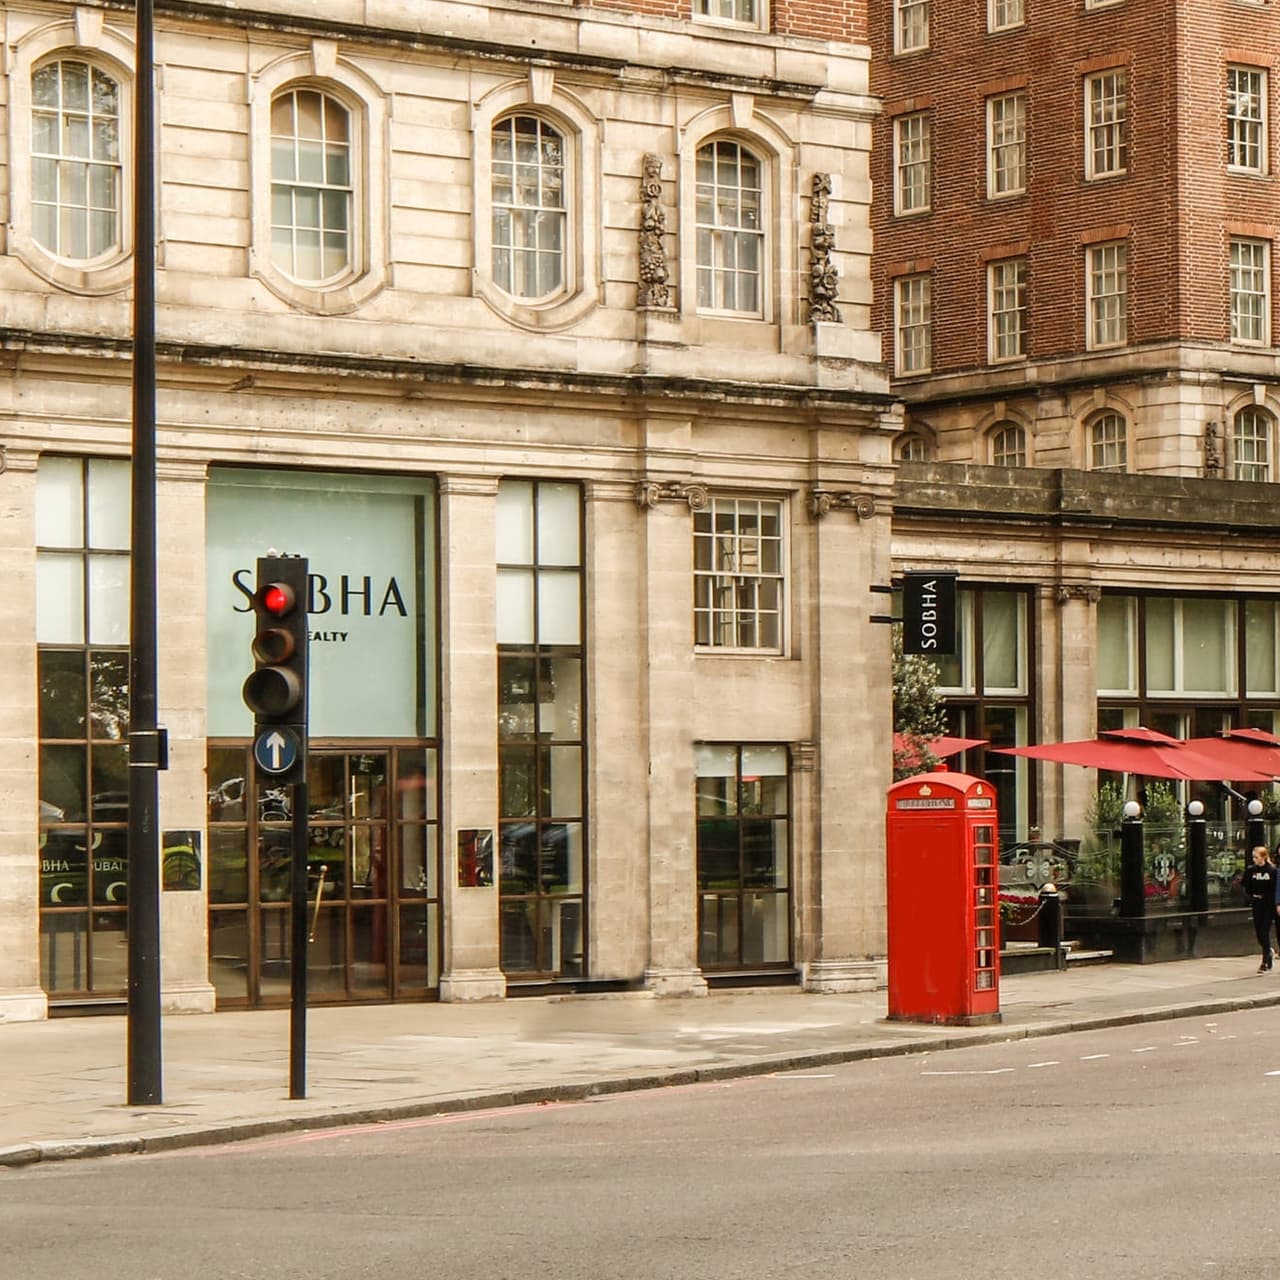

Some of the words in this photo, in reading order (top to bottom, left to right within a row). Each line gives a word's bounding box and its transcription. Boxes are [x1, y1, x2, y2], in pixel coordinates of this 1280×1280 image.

[232, 569, 408, 617] SBHA
[921, 580, 937, 649] SOBHA
[307, 631, 349, 642] EALTY
[42, 859, 69, 872] BHA
[94, 860, 123, 871] UBAI
